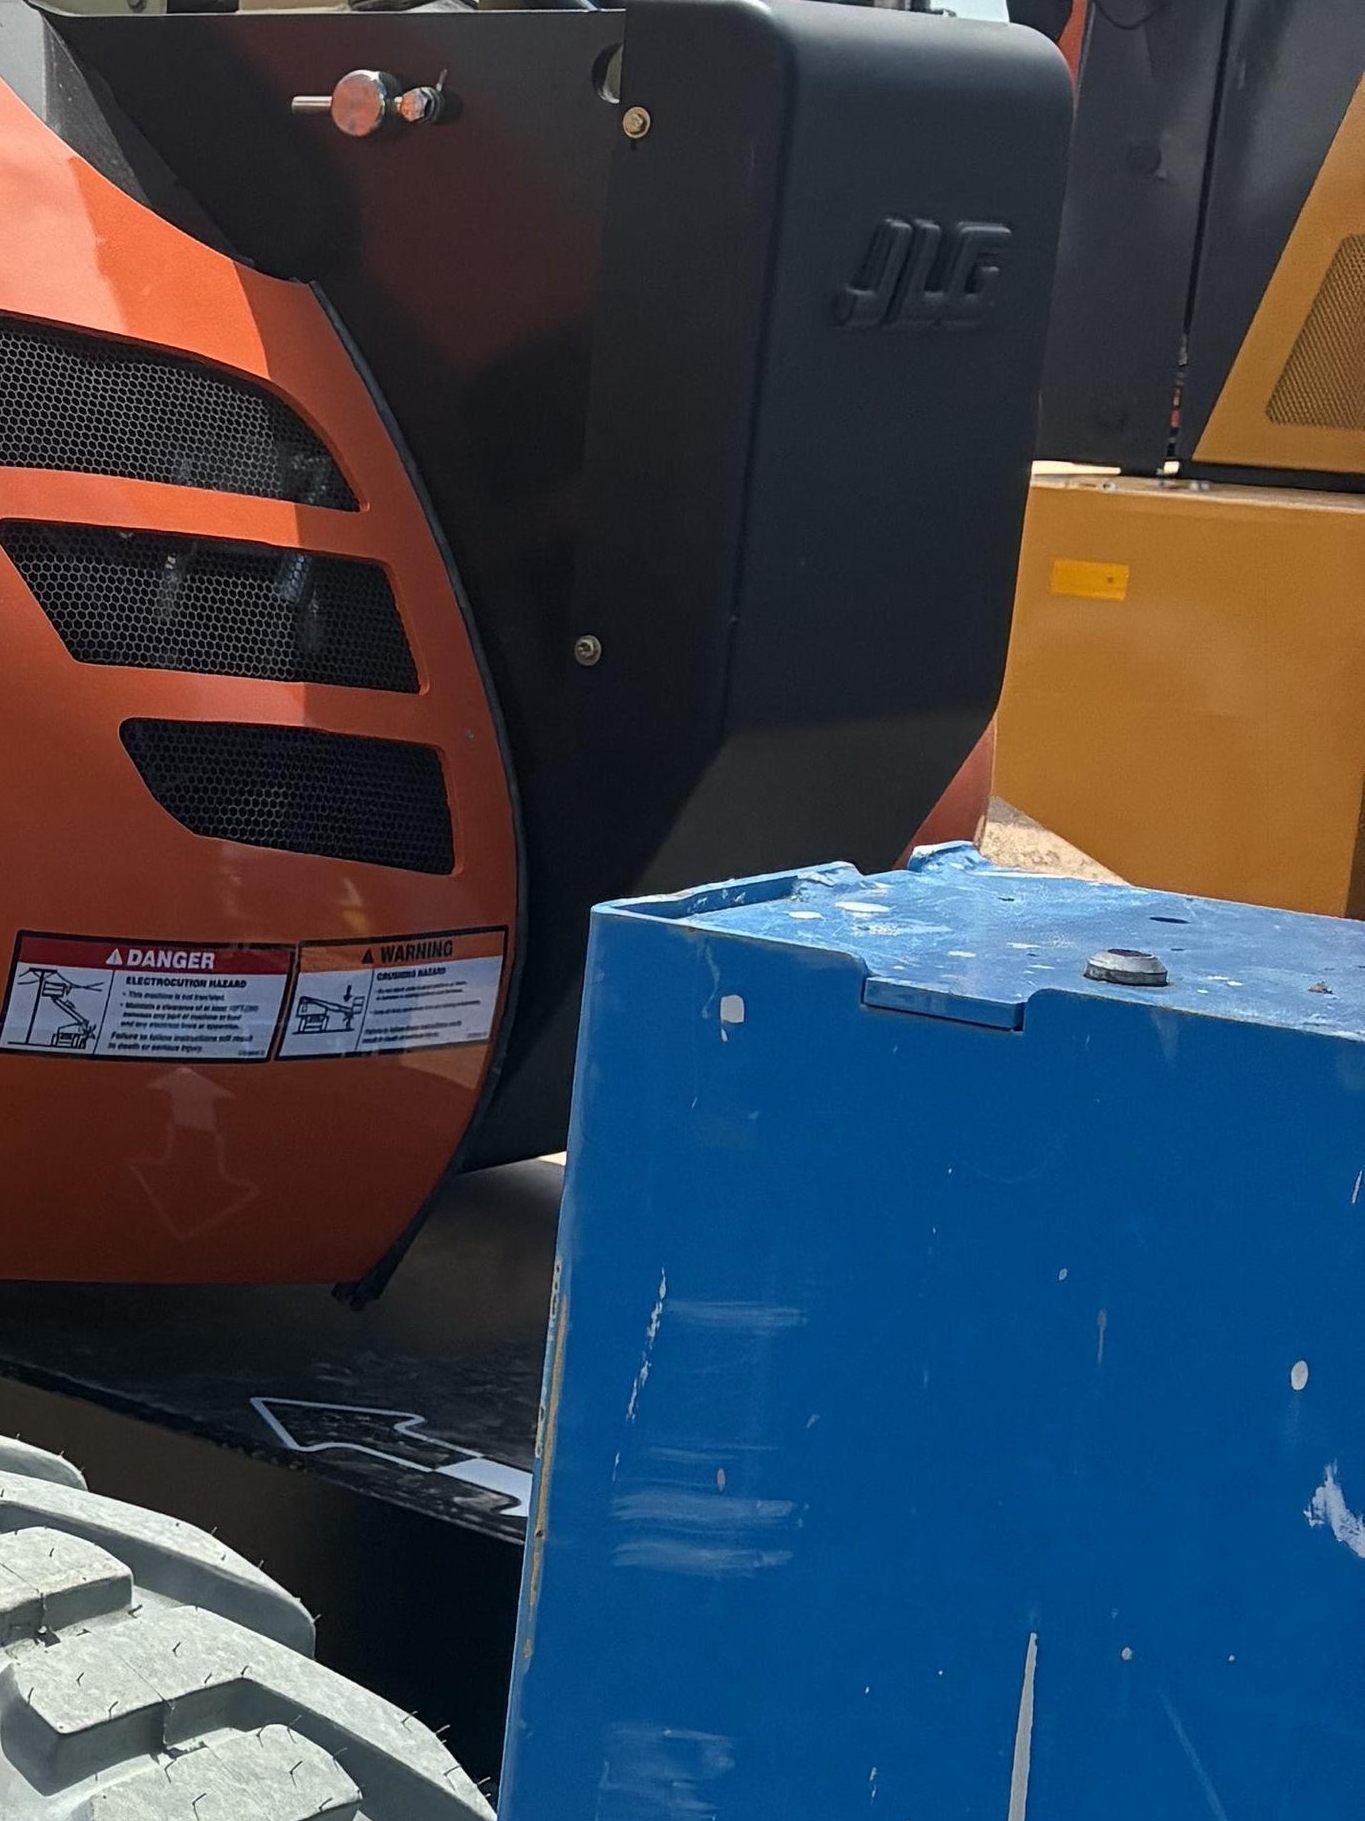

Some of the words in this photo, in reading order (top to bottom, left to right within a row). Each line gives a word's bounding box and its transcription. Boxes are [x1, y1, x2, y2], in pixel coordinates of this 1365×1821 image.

[832, 218, 1011, 327] JLG
[127, 949, 215, 969] DANGER
[381, 940, 453, 963] WARNING
[126, 976, 207, 988] ELECTROCUTION
[208, 979, 247, 989] HAZARD
